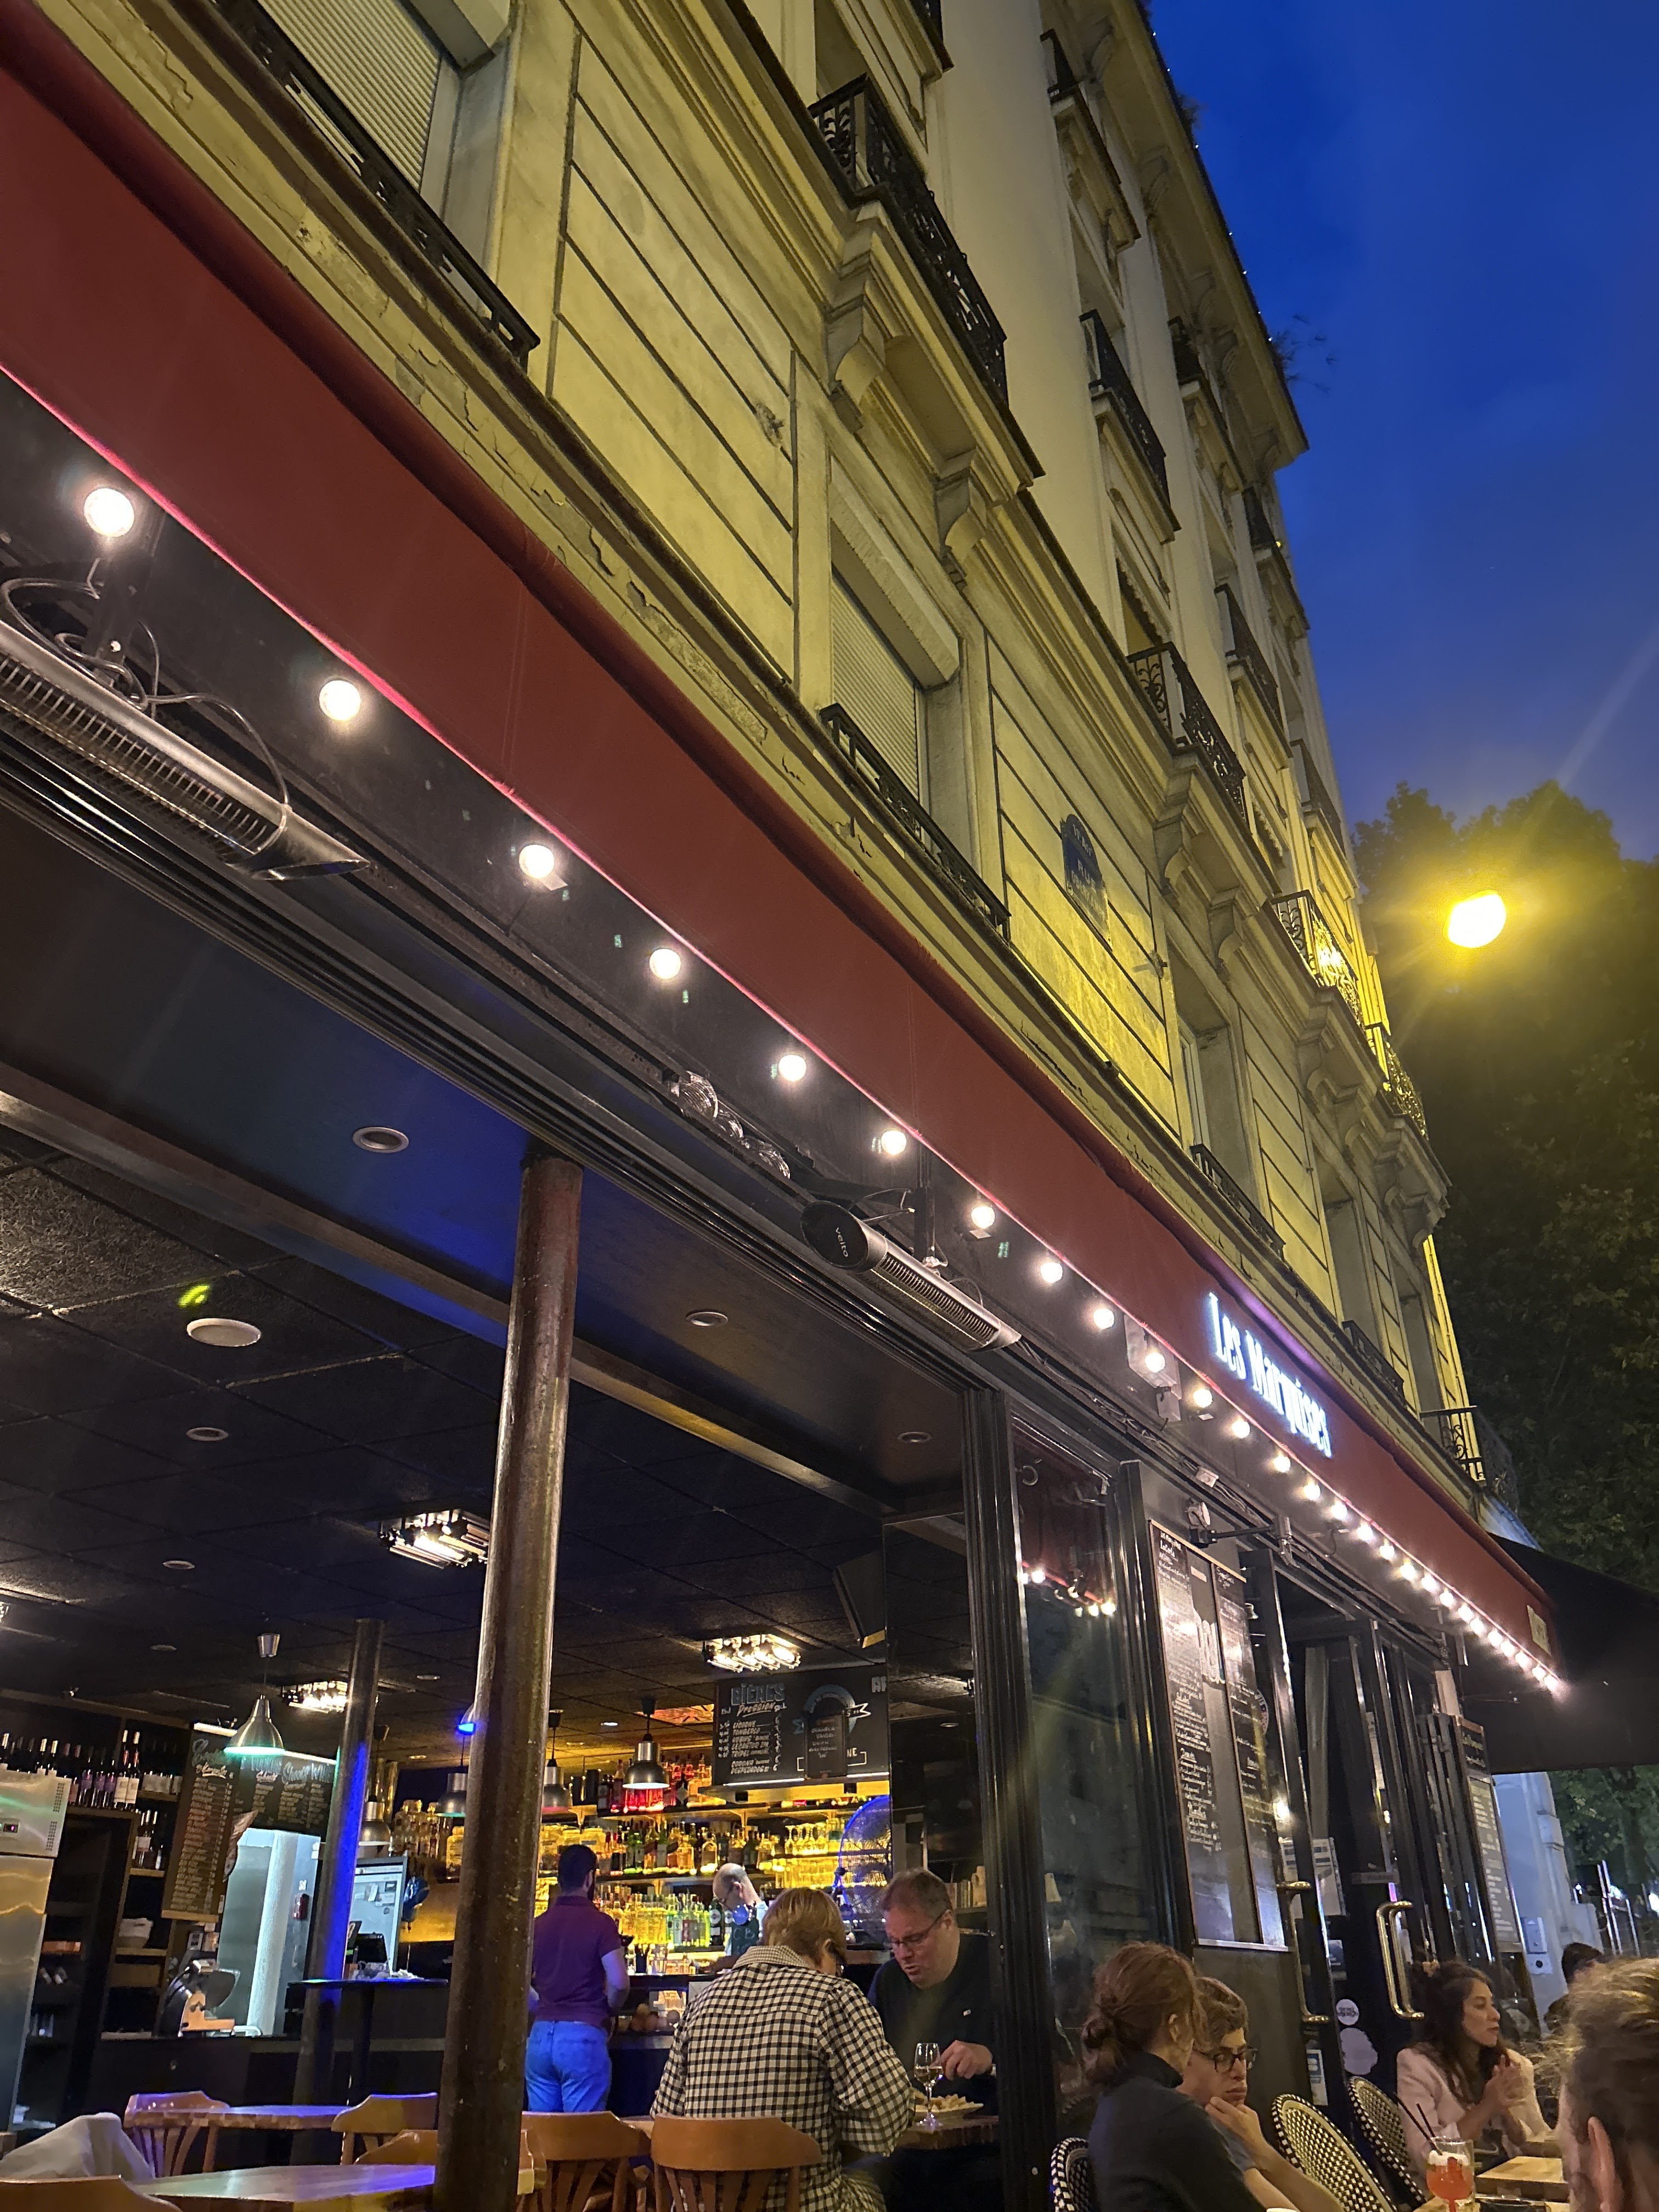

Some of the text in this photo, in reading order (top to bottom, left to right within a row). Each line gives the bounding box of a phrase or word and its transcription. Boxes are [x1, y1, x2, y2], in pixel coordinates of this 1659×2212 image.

[1077, 859, 1096, 894] RUE
[1209, 1292, 1332, 1459] Les Marquises
